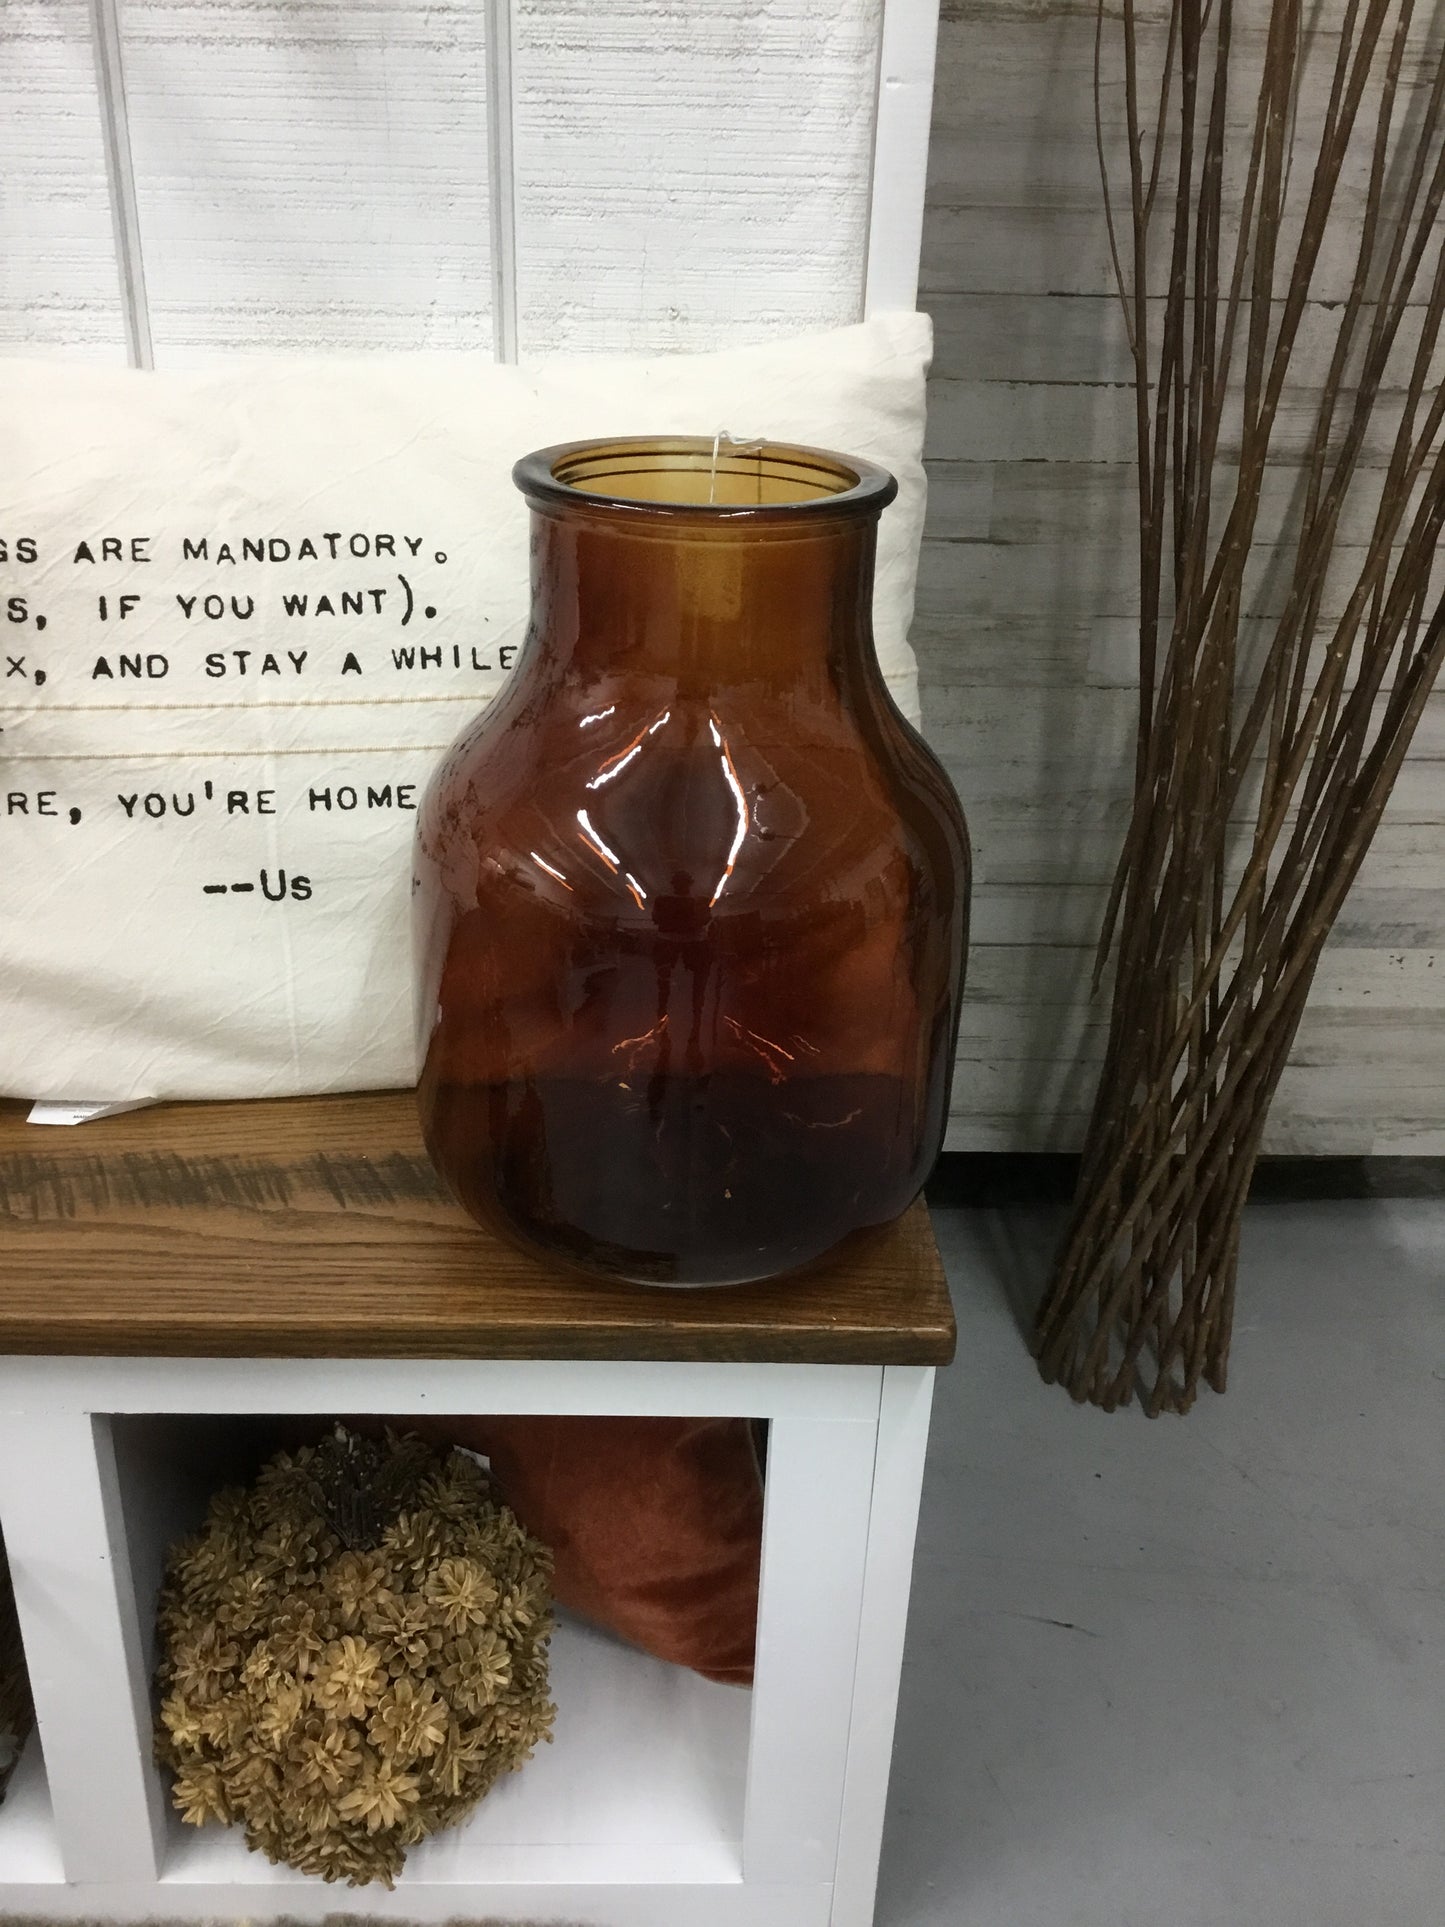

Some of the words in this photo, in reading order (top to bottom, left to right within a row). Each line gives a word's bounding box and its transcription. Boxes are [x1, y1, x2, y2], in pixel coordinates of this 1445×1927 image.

[73, 537, 151, 564] ARE
[183, 532, 448, 565] MANDATORY.
[99, 594, 141, 622] IF
[176, 594, 254, 620] YOU
[282, 574, 437, 626] WANT).
[92, 653, 169, 680] AND
[205, 650, 308, 678] STAY
[341, 652, 362, 675] A
[391, 644, 518, 671] WHILE
[117, 780, 276, 818] YOU'RE
[308, 784, 417, 811] HOME
